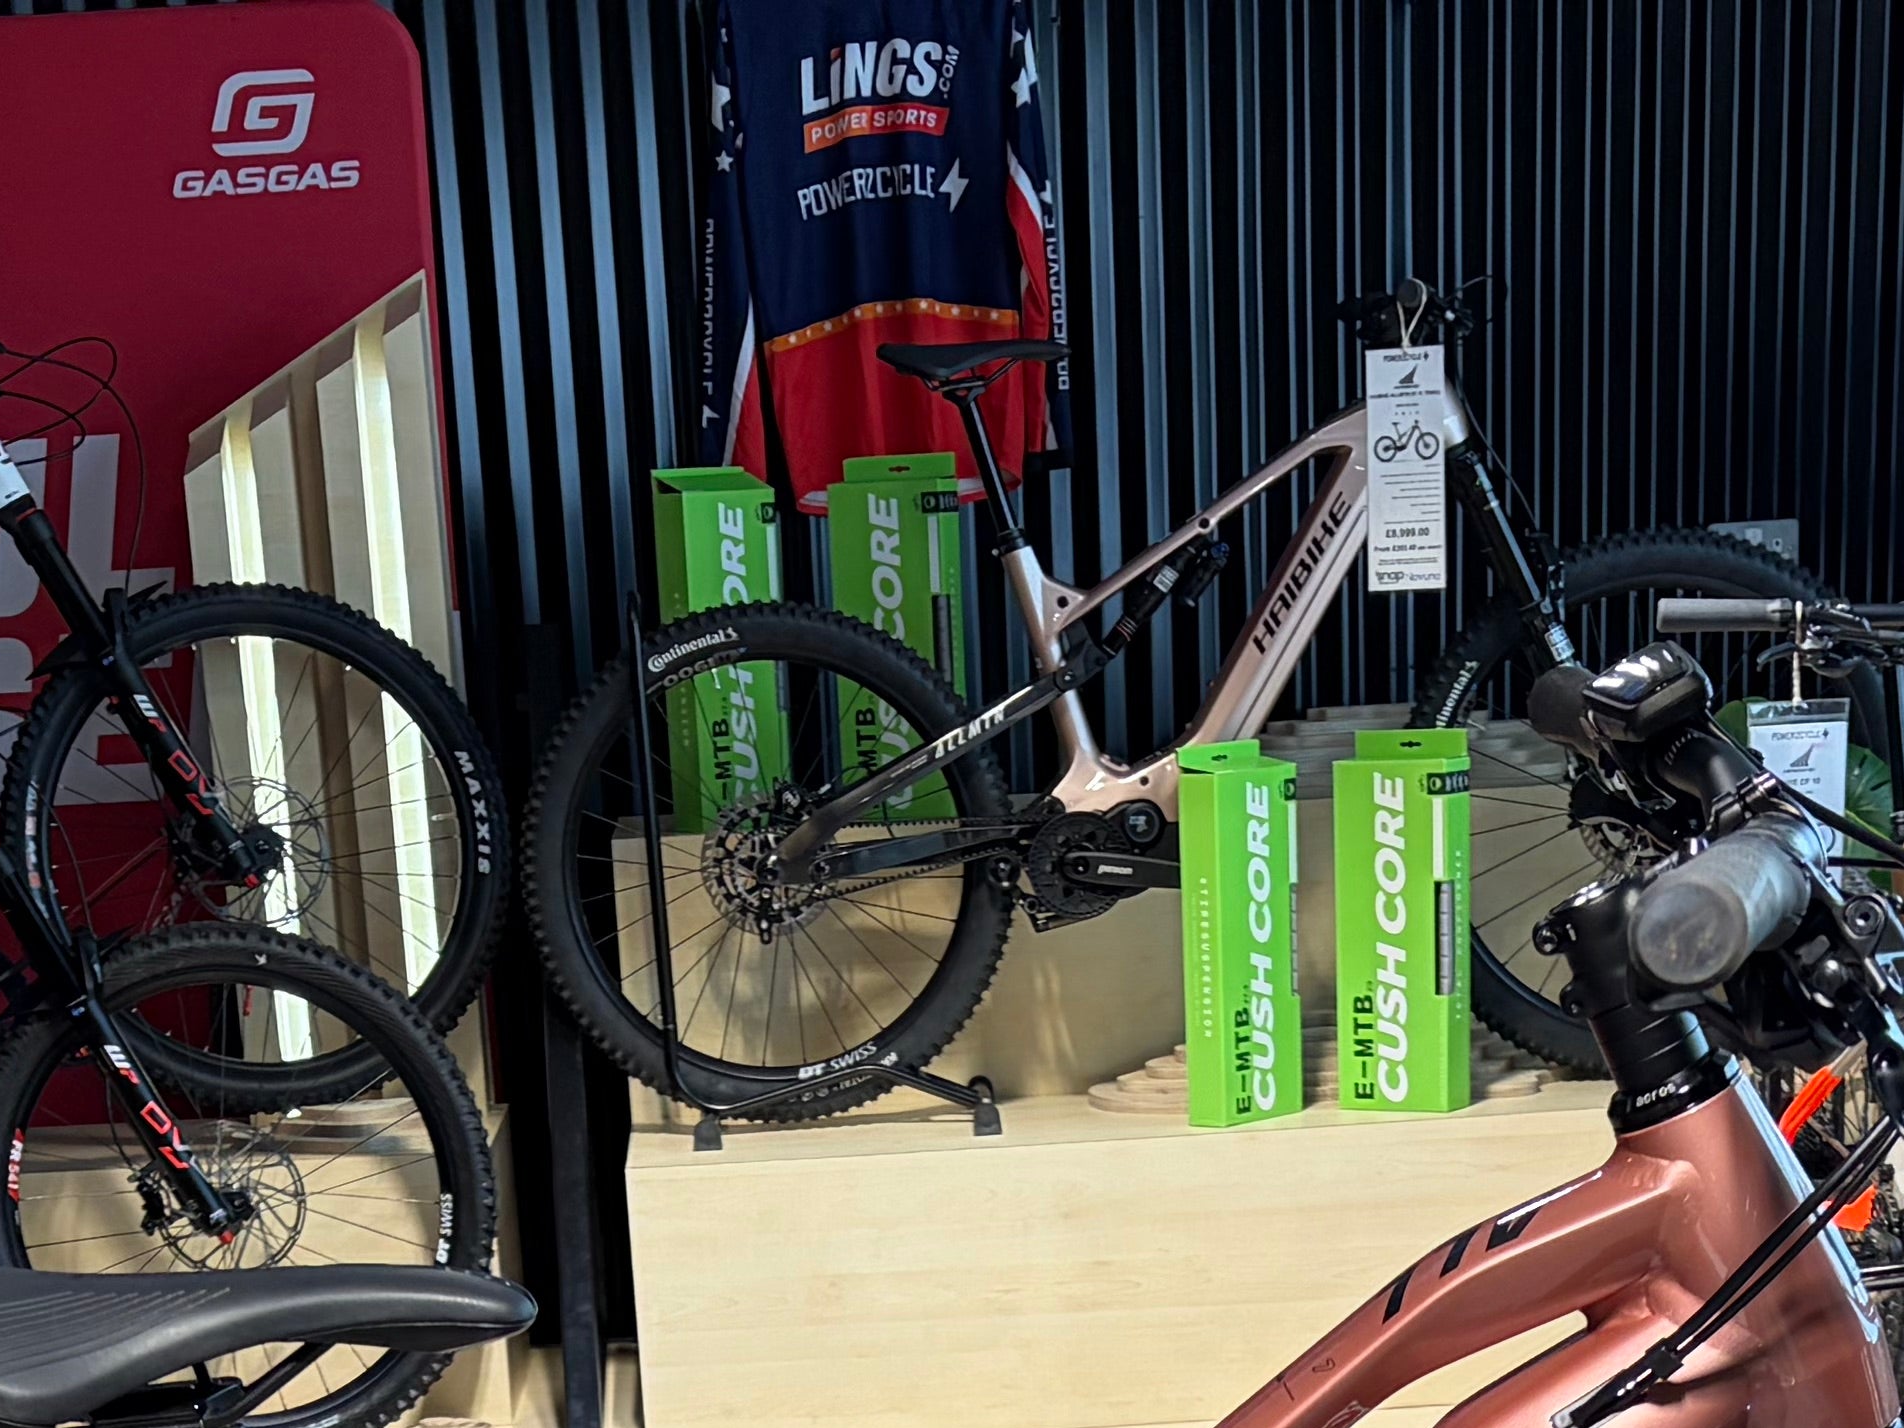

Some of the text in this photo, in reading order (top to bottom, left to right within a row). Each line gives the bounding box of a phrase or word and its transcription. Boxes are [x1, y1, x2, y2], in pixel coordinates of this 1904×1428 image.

[172, 160, 360, 200] GASGAS
[811, 104, 940, 139] POWER SPORTS
[717, 501, 747, 604] ORE
[1251, 491, 1352, 656] HAIBIKE
[647, 628, 733, 673] Continental
[454, 750, 492, 875] MAXXIS
[1245, 781, 1272, 944] CORE
[1373, 771, 1407, 936] CORE
[1250, 956, 1277, 1112] CUSH
[1376, 942, 1410, 1103] CUSH
